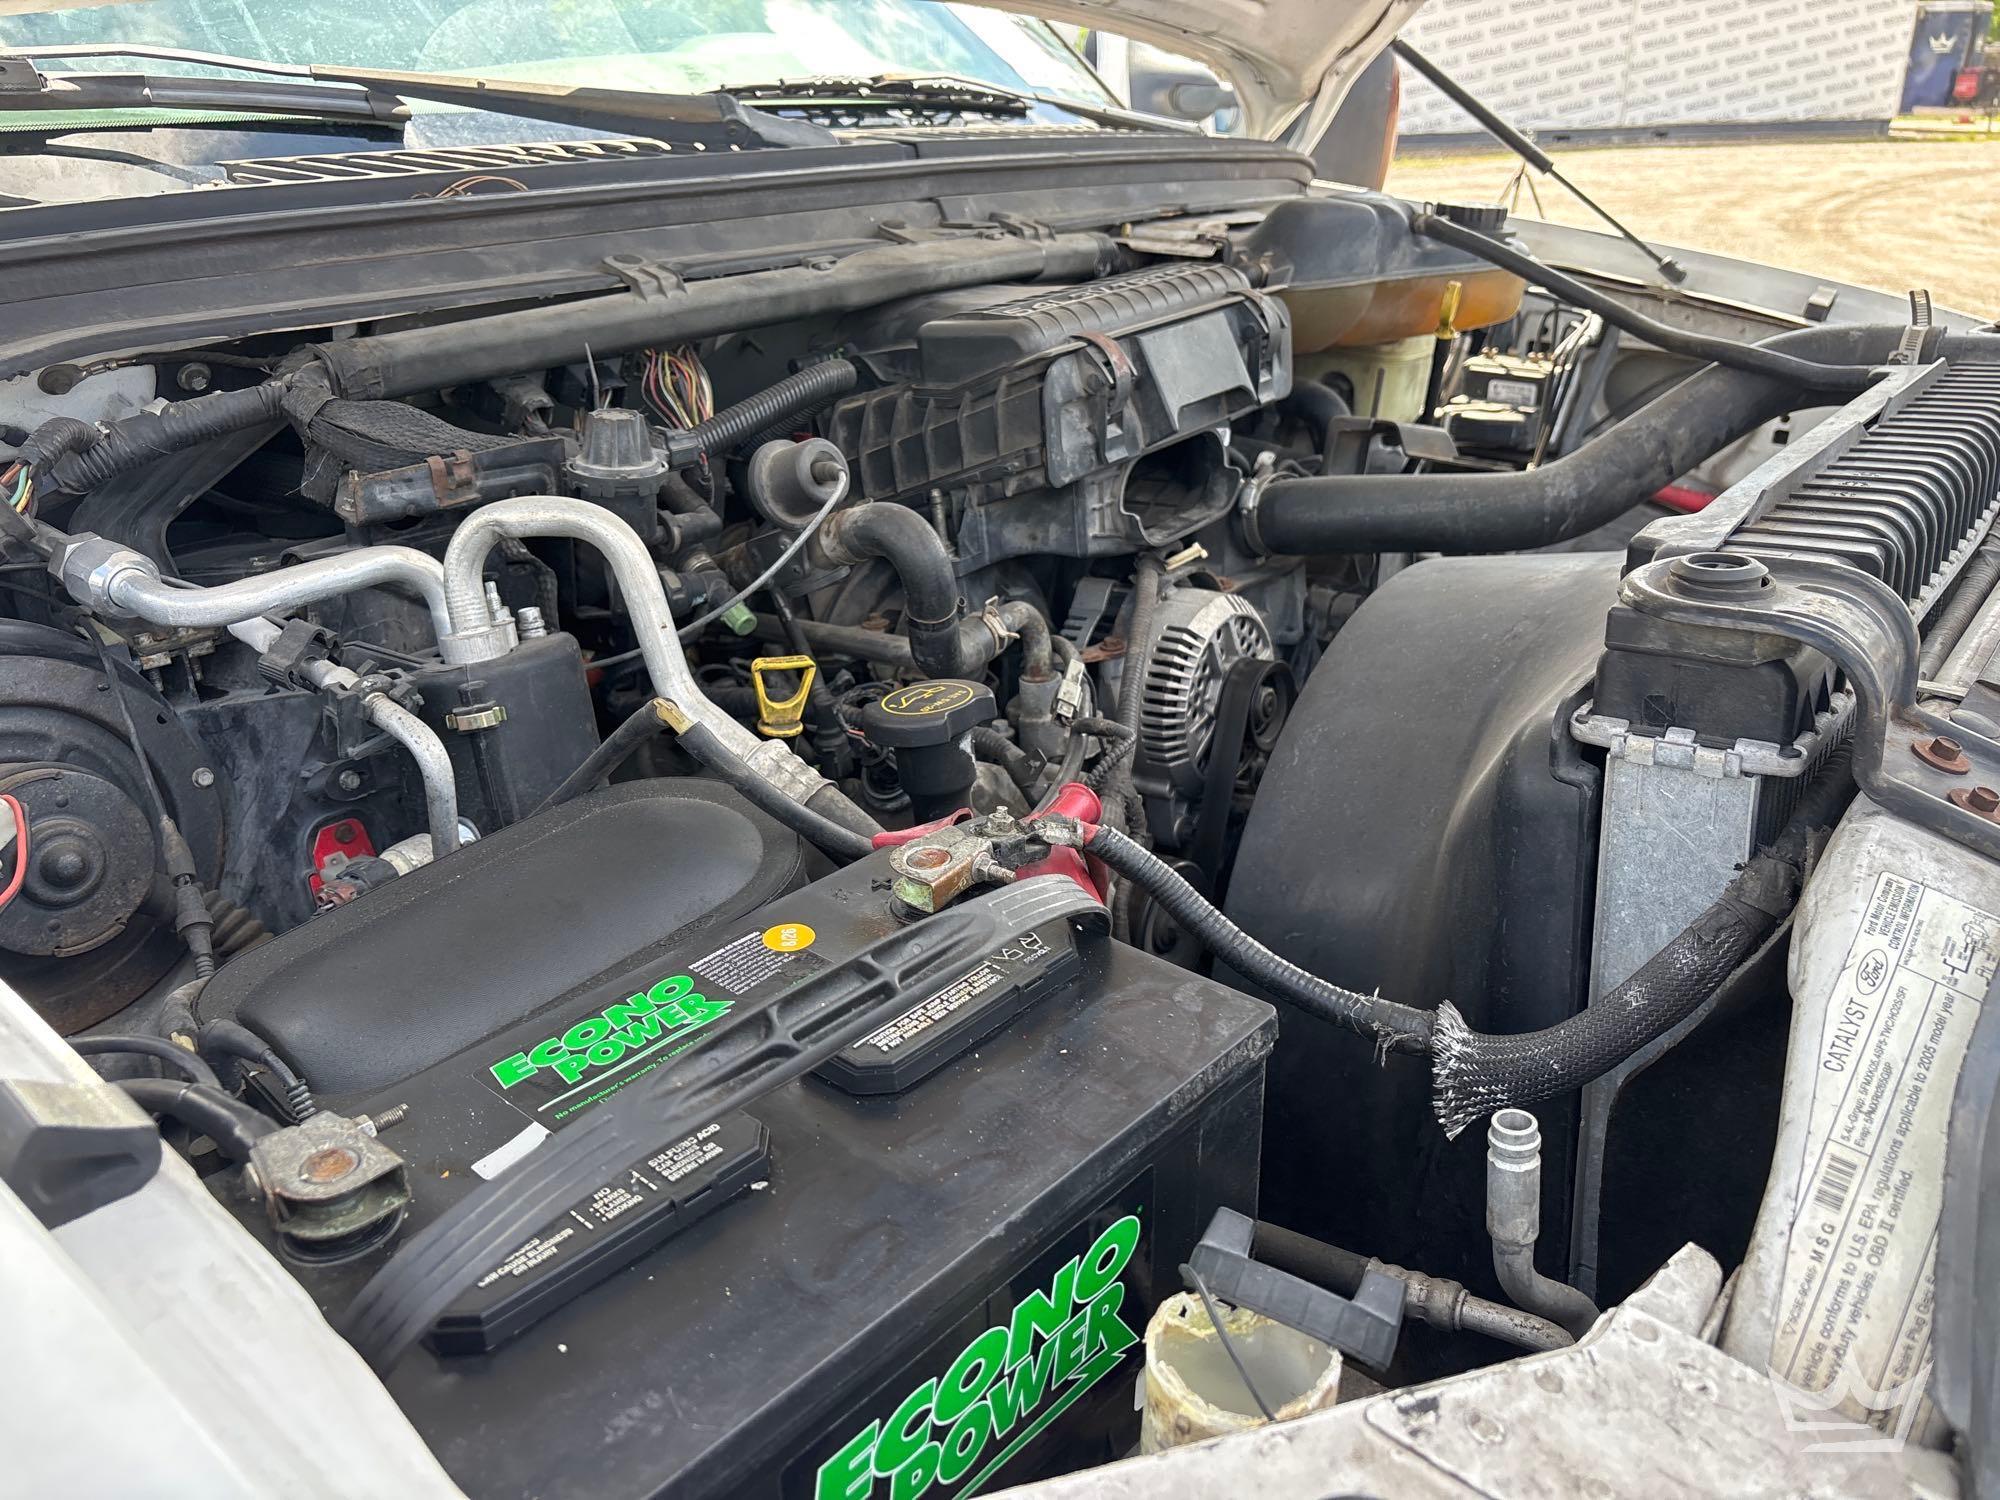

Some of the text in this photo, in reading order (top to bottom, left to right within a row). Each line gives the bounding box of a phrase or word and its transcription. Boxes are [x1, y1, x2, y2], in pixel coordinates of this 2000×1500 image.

[1864, 919, 1878, 936] Ford
[1870, 902, 1885, 920] Motor
[1878, 884, 1905, 936] VEHICLE EMISSION
[1888, 884, 1920, 950] CONTROL INFORMATION
[780, 928, 798, 947] 8/26
[1860, 956, 1884, 987] Ford
[489, 974, 694, 1090] ECONO
[558, 993, 735, 1084] POWER
[1824, 997, 1868, 1072] CATALYST
[555, 1109, 568, 1120] No
[569, 1080, 624, 1112] manufacturer's
[658, 1056, 668, 1064] To
[668, 1041, 694, 1058] replace
[648, 1123, 720, 1168] SULFURIC ACID
[655, 1144, 700, 1172] CAN CAUSE
[661, 1142, 717, 1176] BLINDNESS OR
[1854, 1125, 1872, 1148] Evap:
[668, 1146, 724, 1182] SEVERE BURNS
[593, 1187, 612, 1200] NO
[1802, 992, 1956, 1387] vehicle conforms to U.S. EPA regulations applicable to 2005 model year
[496, 1255, 528, 1275] CAUSE
[526, 1228, 574, 1258] BLINDNESS
[512, 1264, 528, 1276] OR
[1848, 1270, 1877, 1324] vehicles.
[1866, 1234, 1888, 1267] OBD
[1878, 1220, 1896, 1234] II
[1888, 1170, 1914, 1219] certified.
[814, 1215, 1141, 1500] ECONO
[891, 1281, 1139, 1500] POWER
